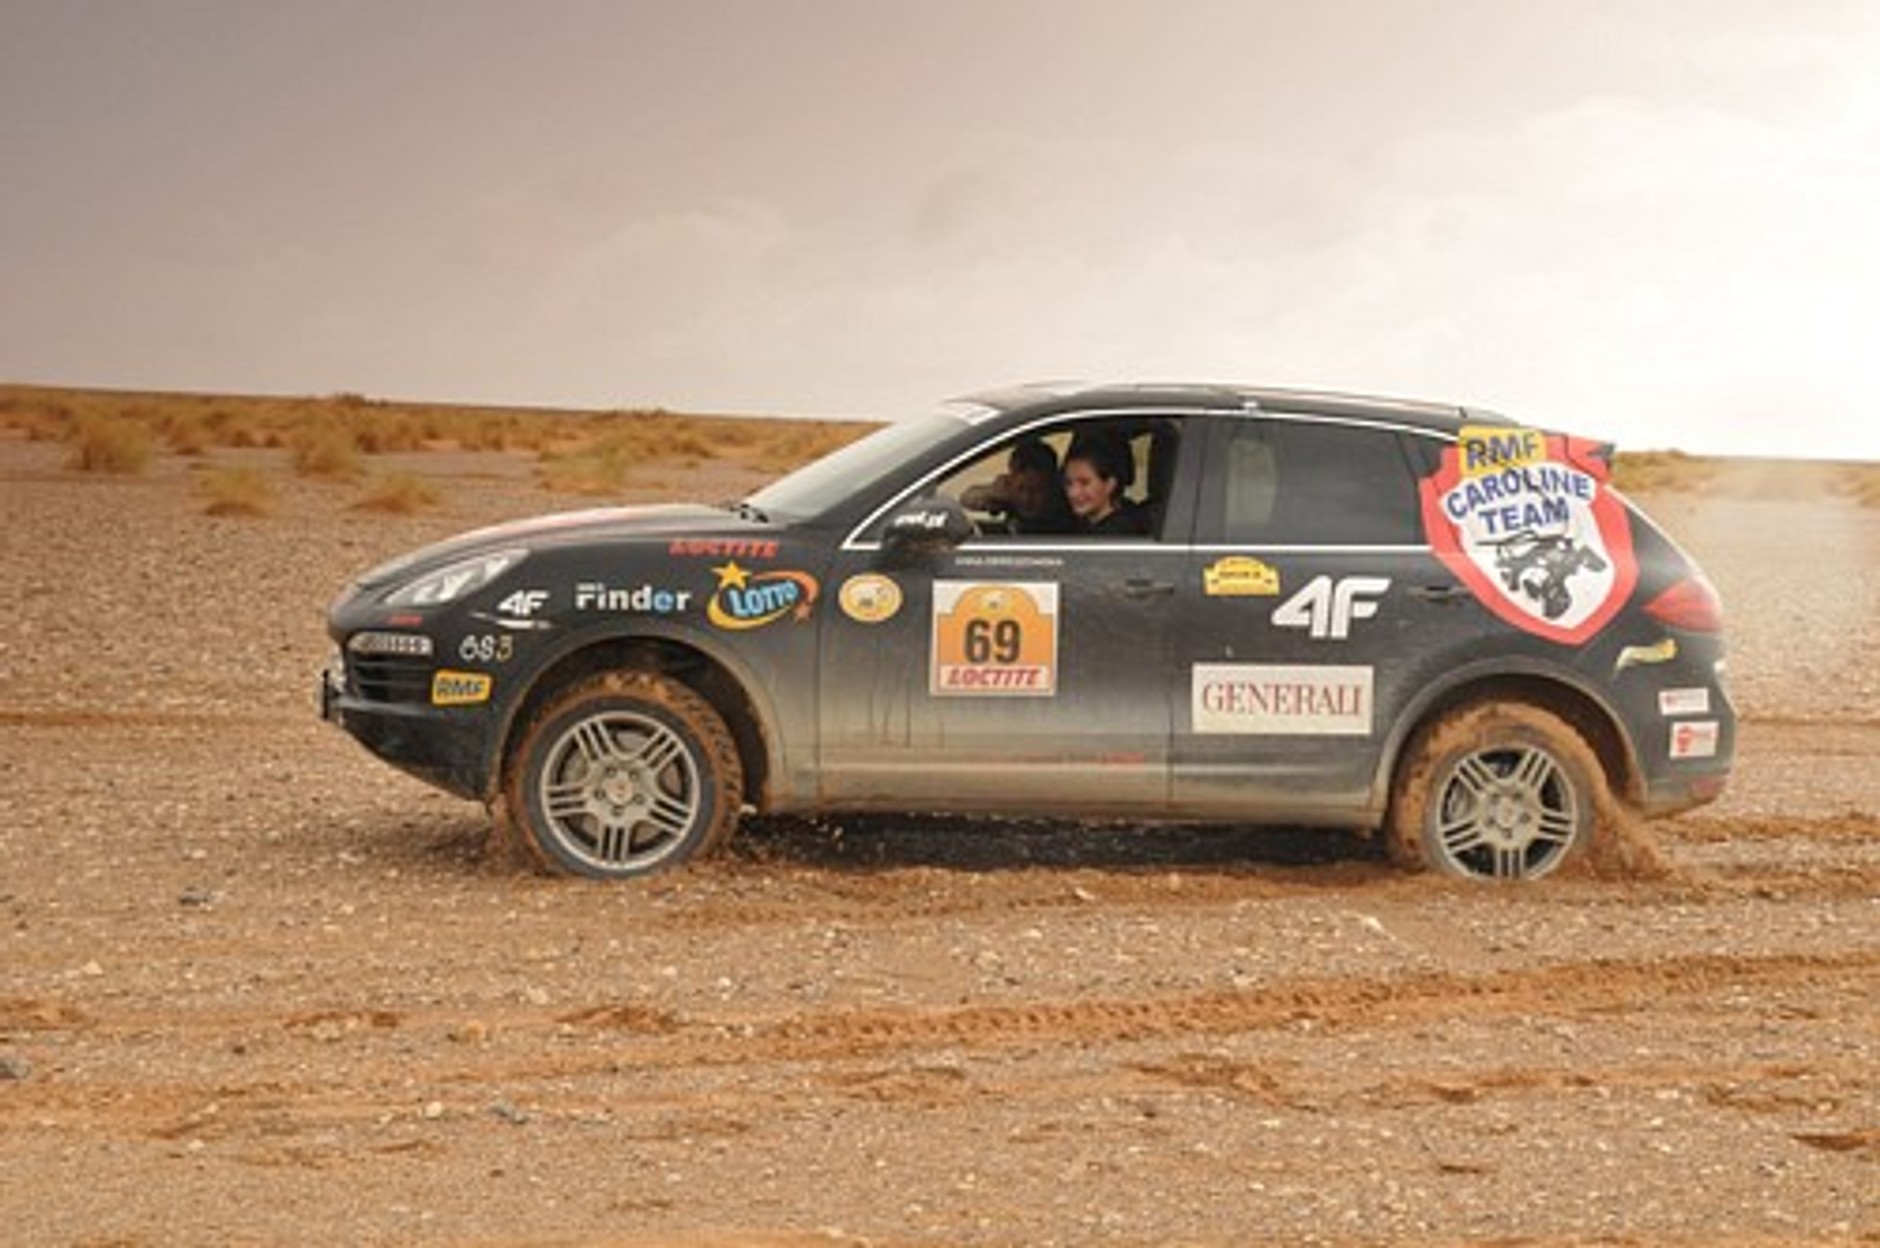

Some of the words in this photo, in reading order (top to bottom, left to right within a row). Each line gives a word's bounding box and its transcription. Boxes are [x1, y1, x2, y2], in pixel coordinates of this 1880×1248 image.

[1466, 433, 1540, 469] RMF
[1447, 468, 1591, 519] CAROLINE
[1479, 497, 1571, 534] TEAM
[498, 591, 549, 615] 4F
[575, 583, 692, 611] Finder
[728, 580, 799, 616] LOTTO
[1271, 575, 1392, 637] 4F
[964, 620, 1021, 663] 69
[948, 669, 1040, 685] LOCTITE
[1203, 682, 1362, 716] GENERALI
